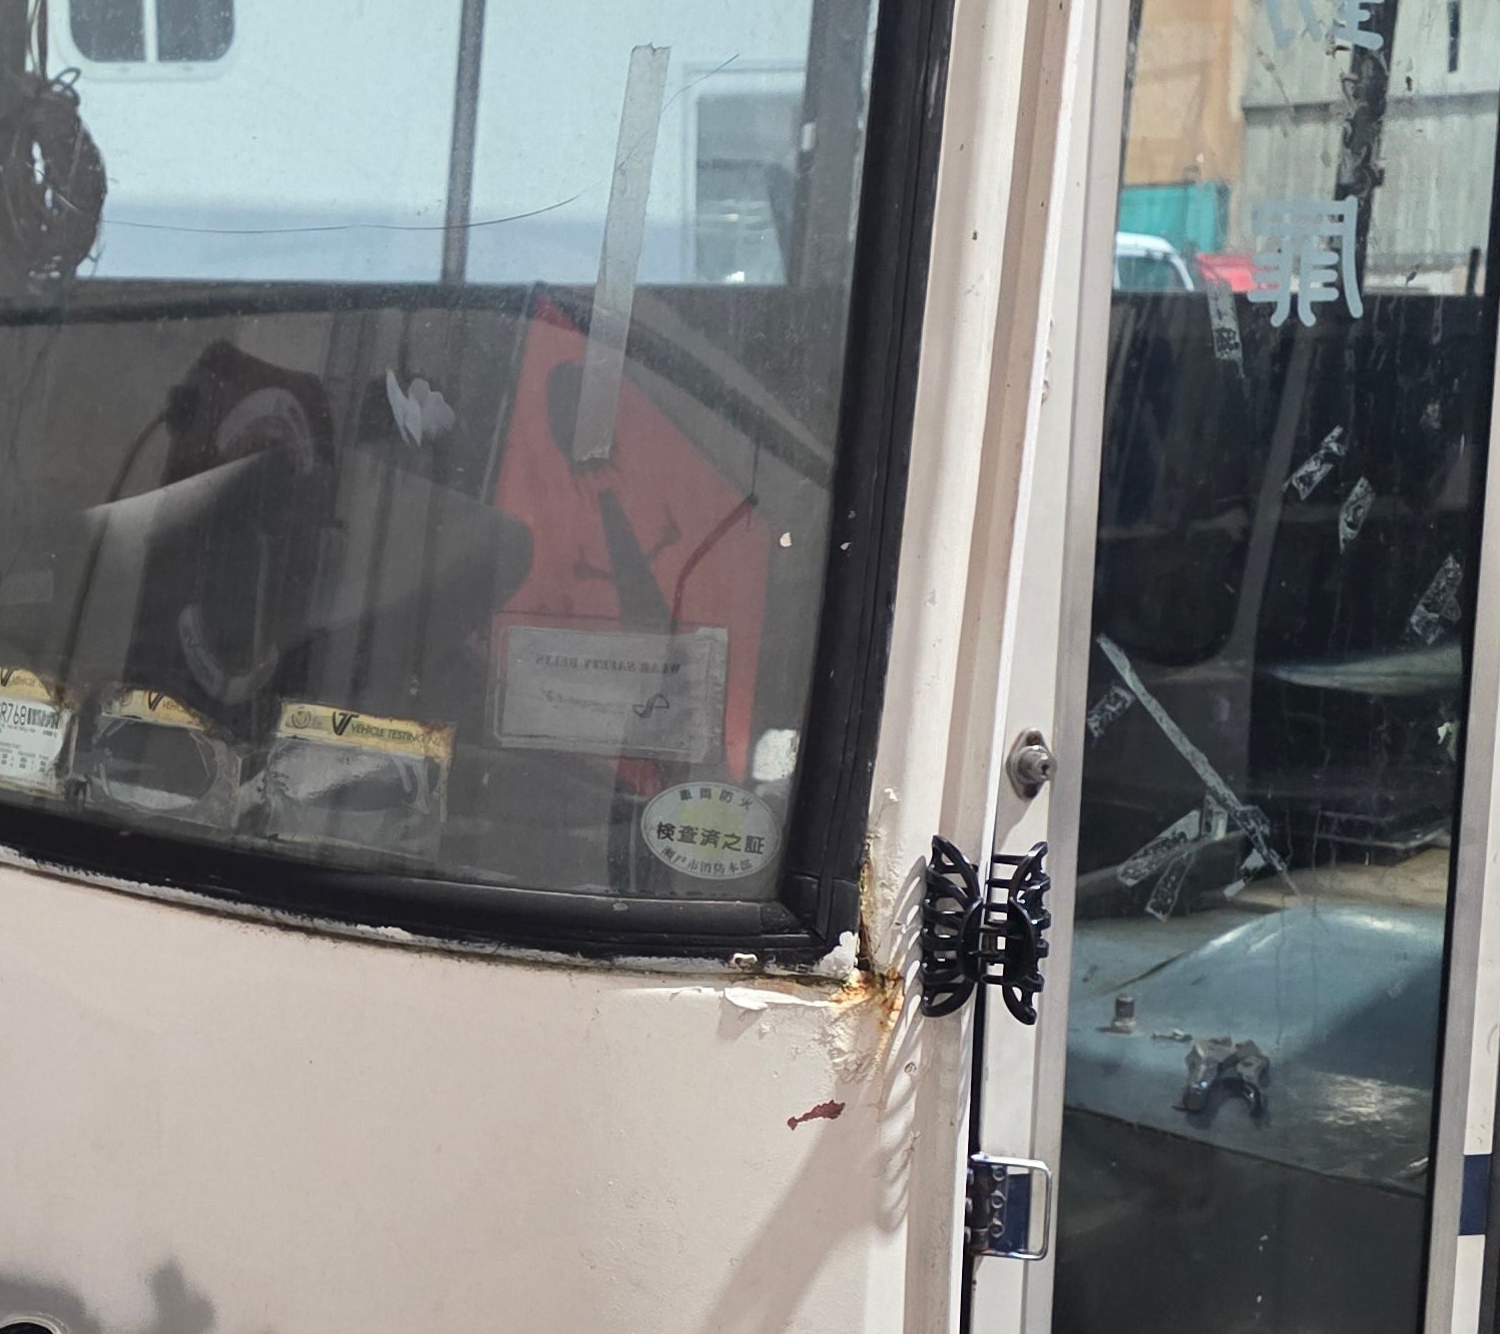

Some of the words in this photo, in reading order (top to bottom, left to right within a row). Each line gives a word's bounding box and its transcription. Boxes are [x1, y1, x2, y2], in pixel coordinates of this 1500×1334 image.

[351, 723, 384, 738] VEHICLE
[387, 728, 426, 744] TESTING
[656, 821, 766, 855] 検査済之証
